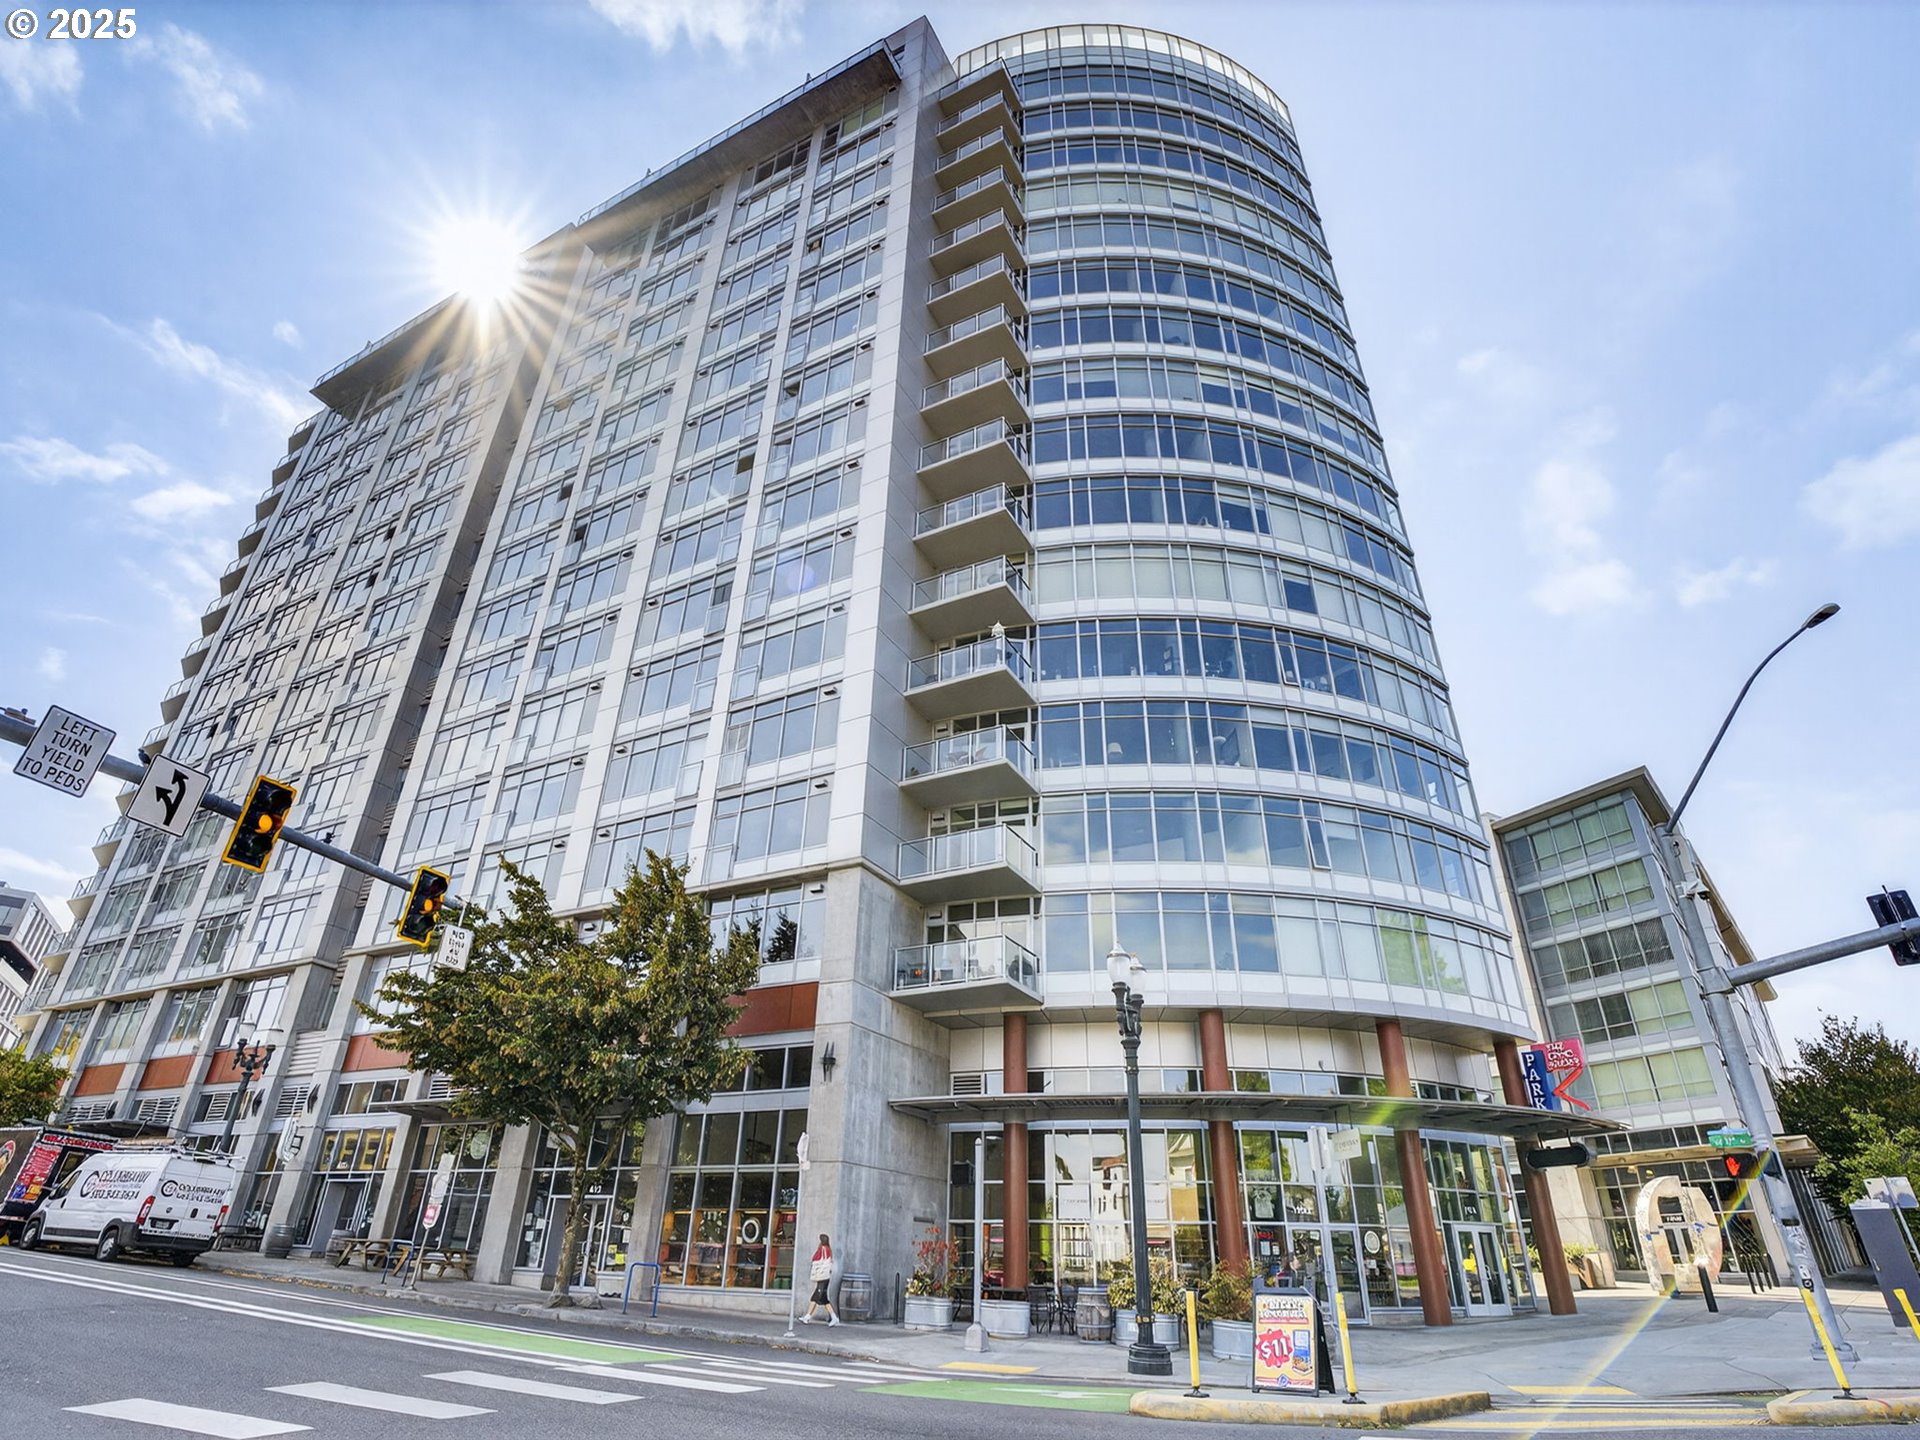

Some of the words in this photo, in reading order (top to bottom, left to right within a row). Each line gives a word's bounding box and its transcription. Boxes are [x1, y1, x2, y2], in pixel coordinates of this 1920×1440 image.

[60, 716, 99, 741] LEFT
[51, 730, 92, 757] TURN
[41, 745, 84, 772] YIELD
[23, 757, 42, 775] TO
[43, 766, 85, 791] PEDS
[1525, 1053, 1547, 1109] PARK
[1260, 1338, 1289, 1359] $11
